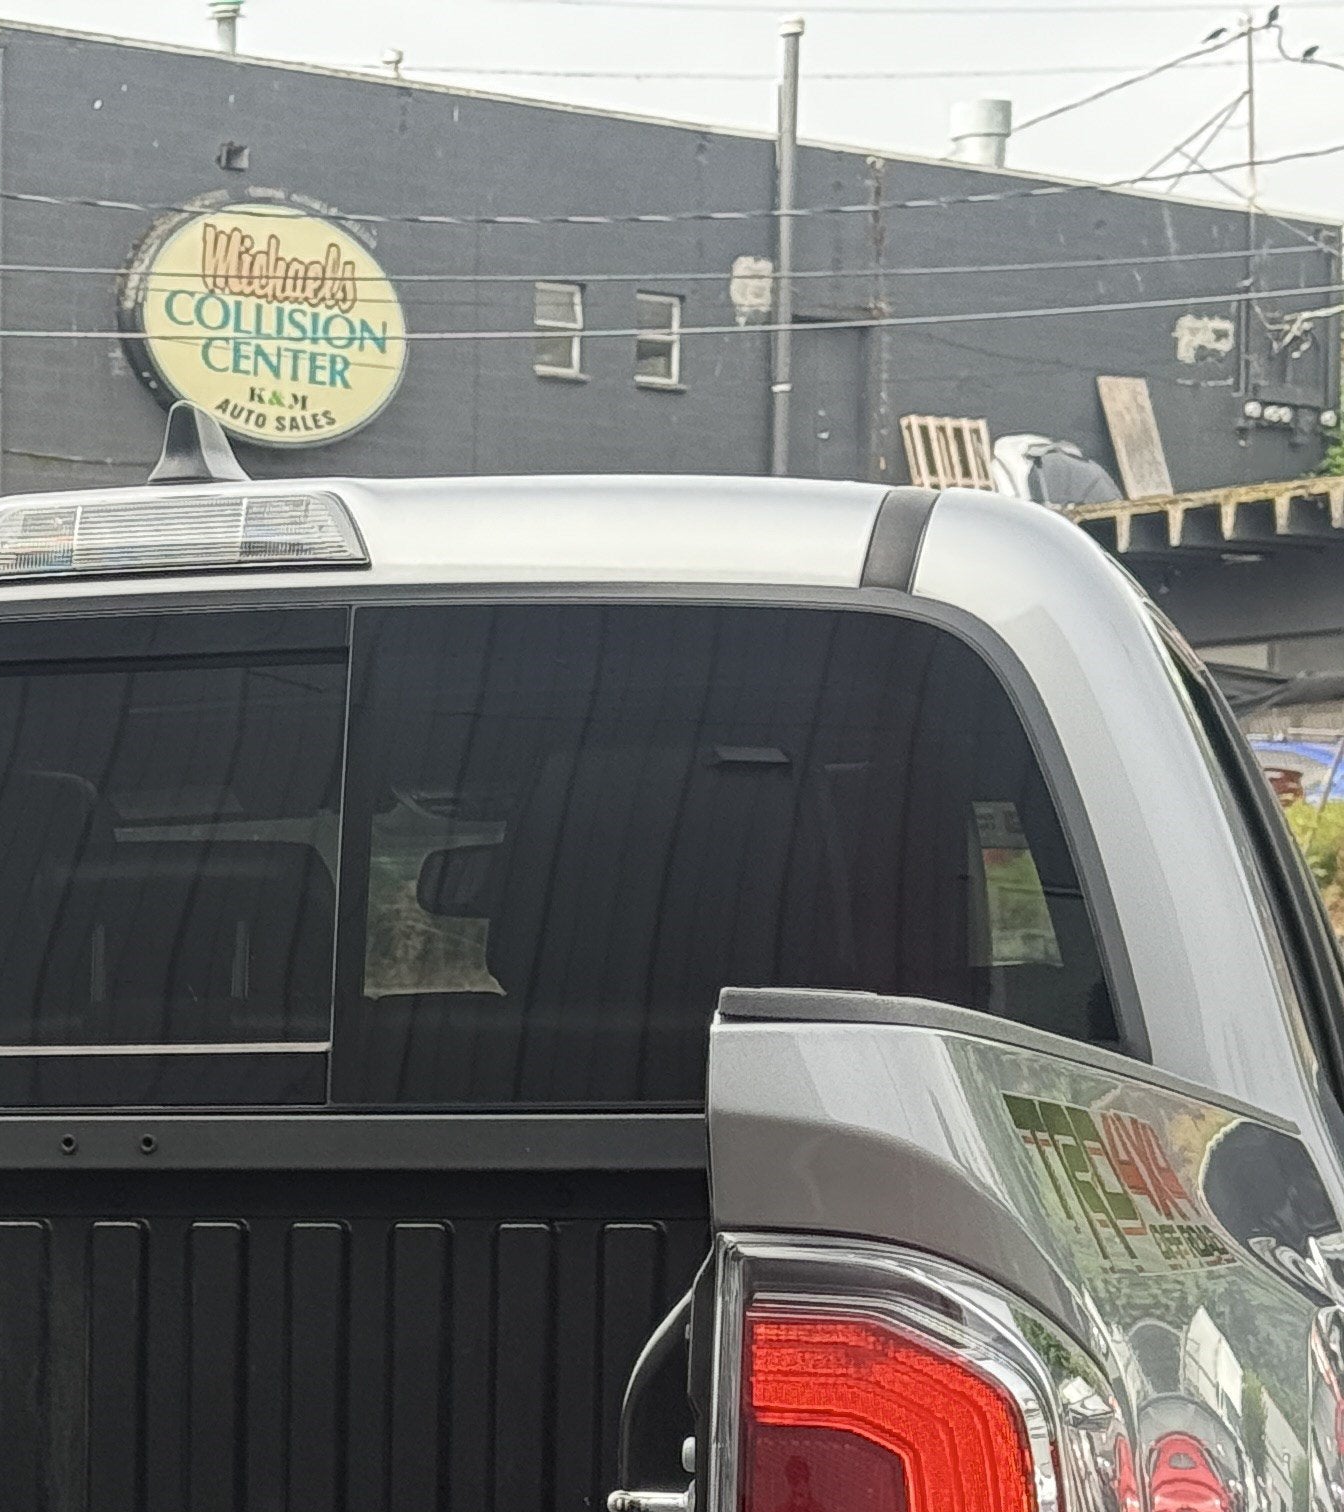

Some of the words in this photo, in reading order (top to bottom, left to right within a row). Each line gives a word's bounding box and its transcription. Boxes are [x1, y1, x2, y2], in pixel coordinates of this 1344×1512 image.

[164, 290, 388, 354] COLLISION
[201, 337, 352, 390] CENTER
[214, 398, 267, 429] AUTO
[275, 409, 337, 432] SALES
